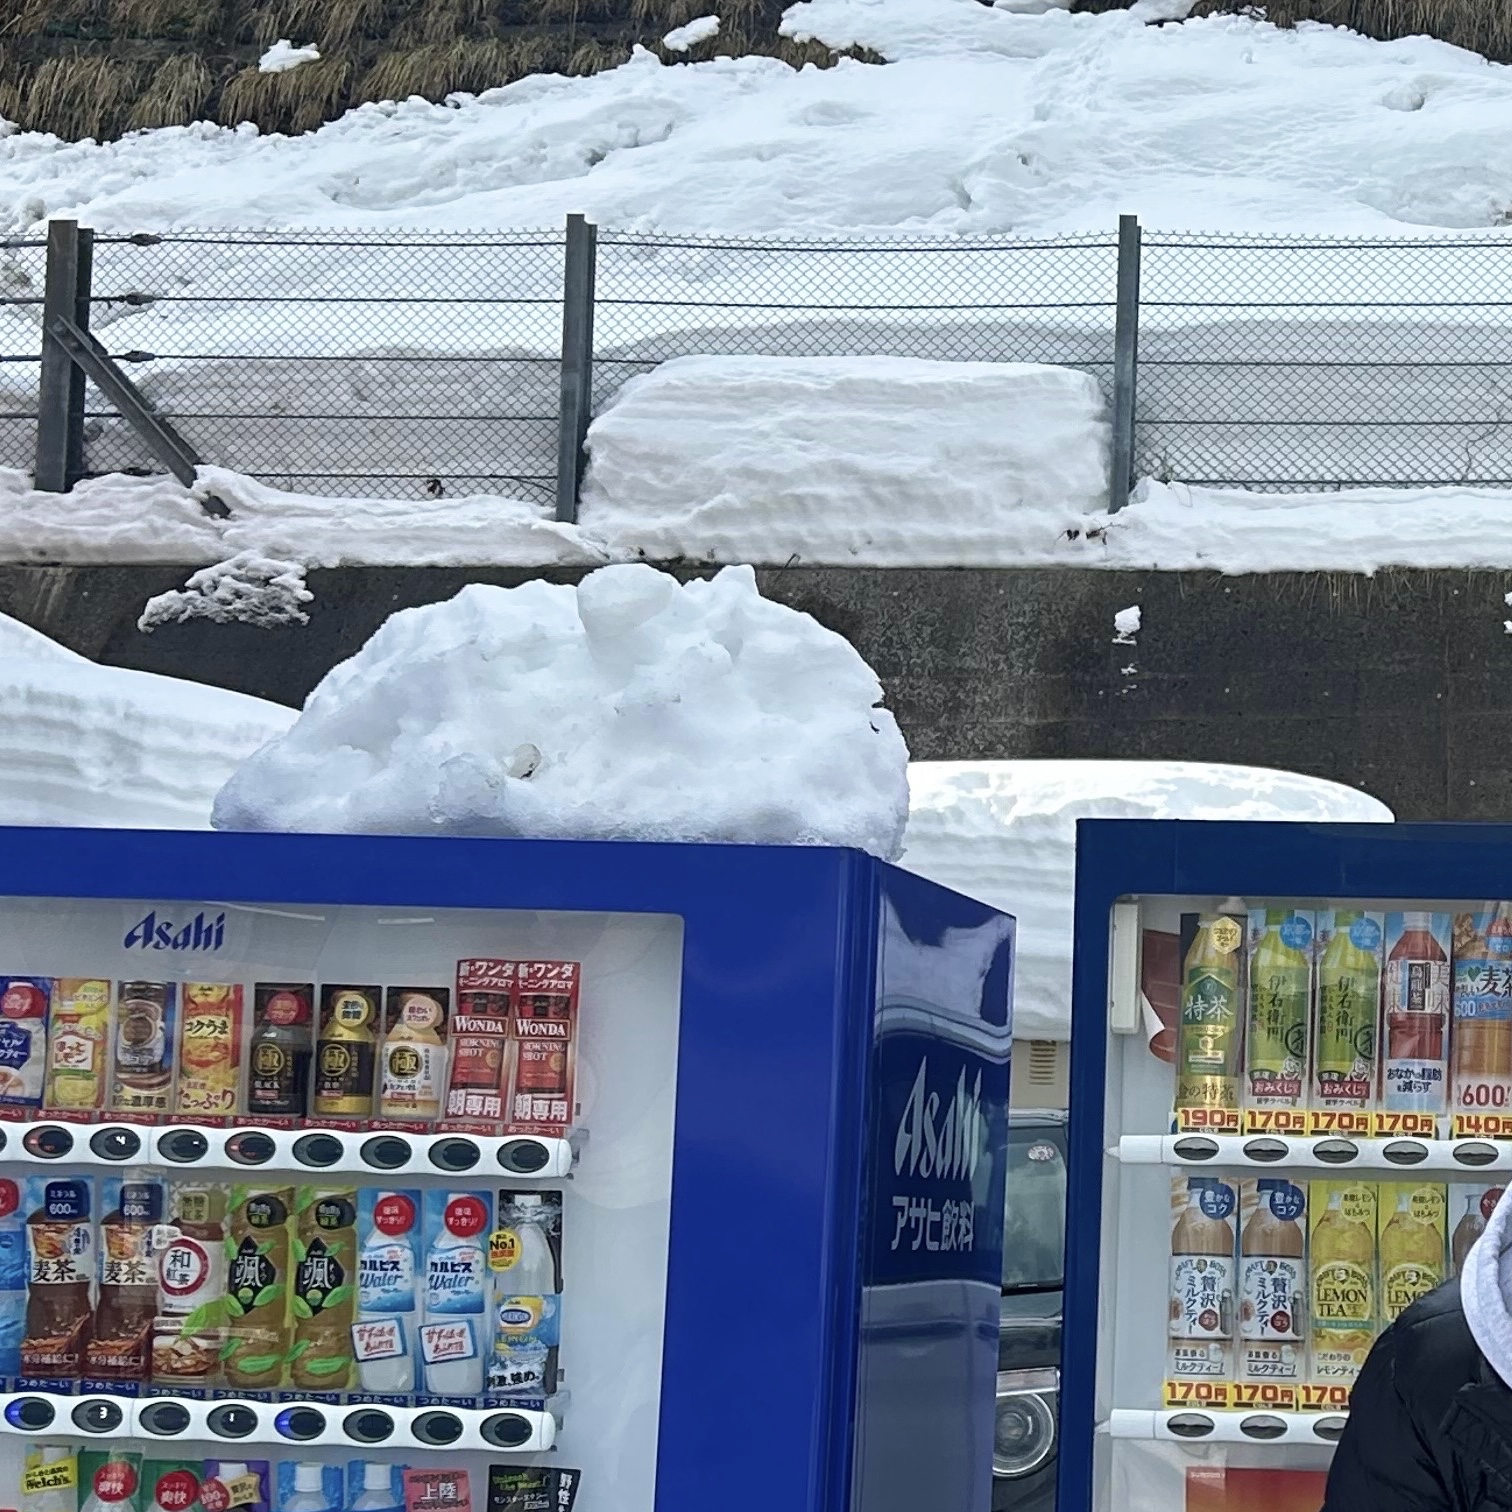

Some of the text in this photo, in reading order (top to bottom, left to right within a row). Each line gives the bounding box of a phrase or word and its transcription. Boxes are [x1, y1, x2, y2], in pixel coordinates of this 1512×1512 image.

[124, 910, 227, 952] Asahi
[518, 963, 574, 978] 新・ワンダ
[1184, 994, 1234, 1021] 特茶
[1267, 975, 1286, 1042] 伊右衛門
[1335, 975, 1355, 1045] 伊右衛門
[455, 1015, 504, 1033] WONDA
[516, 1018, 566, 1036] WONDA
[178, 1089, 236, 1111] たっぷり
[448, 1089, 501, 1117] 朝専用
[1463, 1084, 1505, 1108] 600
[514, 1093, 568, 1121] 朝専用
[895, 1055, 982, 1182] Asahi
[1181, 1109, 1239, 1127] 190円
[1248, 1110, 1305, 1129] 170円
[1312, 1112, 1369, 1131] 170円
[1376, 1113, 1434, 1132] 170円
[1207, 1204, 1228, 1215] コク
[1276, 1206, 1297, 1216] コク
[891, 1195, 975, 1252] アサヒ飲料
[489, 1239, 515, 1250] No.1
[170, 1249, 191, 1269] 和
[430, 1261, 472, 1274] カルピス
[33, 1259, 77, 1282] 麦茶
[105, 1261, 147, 1283] 麦茶
[428, 1274, 474, 1291] Water
[1200, 1275, 1217, 1309] 贅沢
[1271, 1277, 1288, 1310] 贅沢
[1317, 1288, 1368, 1303] LEMON
[1185, 1275, 1198, 1334] ミルクティー
[1256, 1277, 1269, 1336] ミルクティー
[1320, 1303, 1347, 1317] TEA
[1167, 1382, 1227, 1400] 170円
[1233, 1384, 1294, 1402] 170円
[161, 1491, 186, 1504] 爽快
[420, 1482, 457, 1500] 上陸
